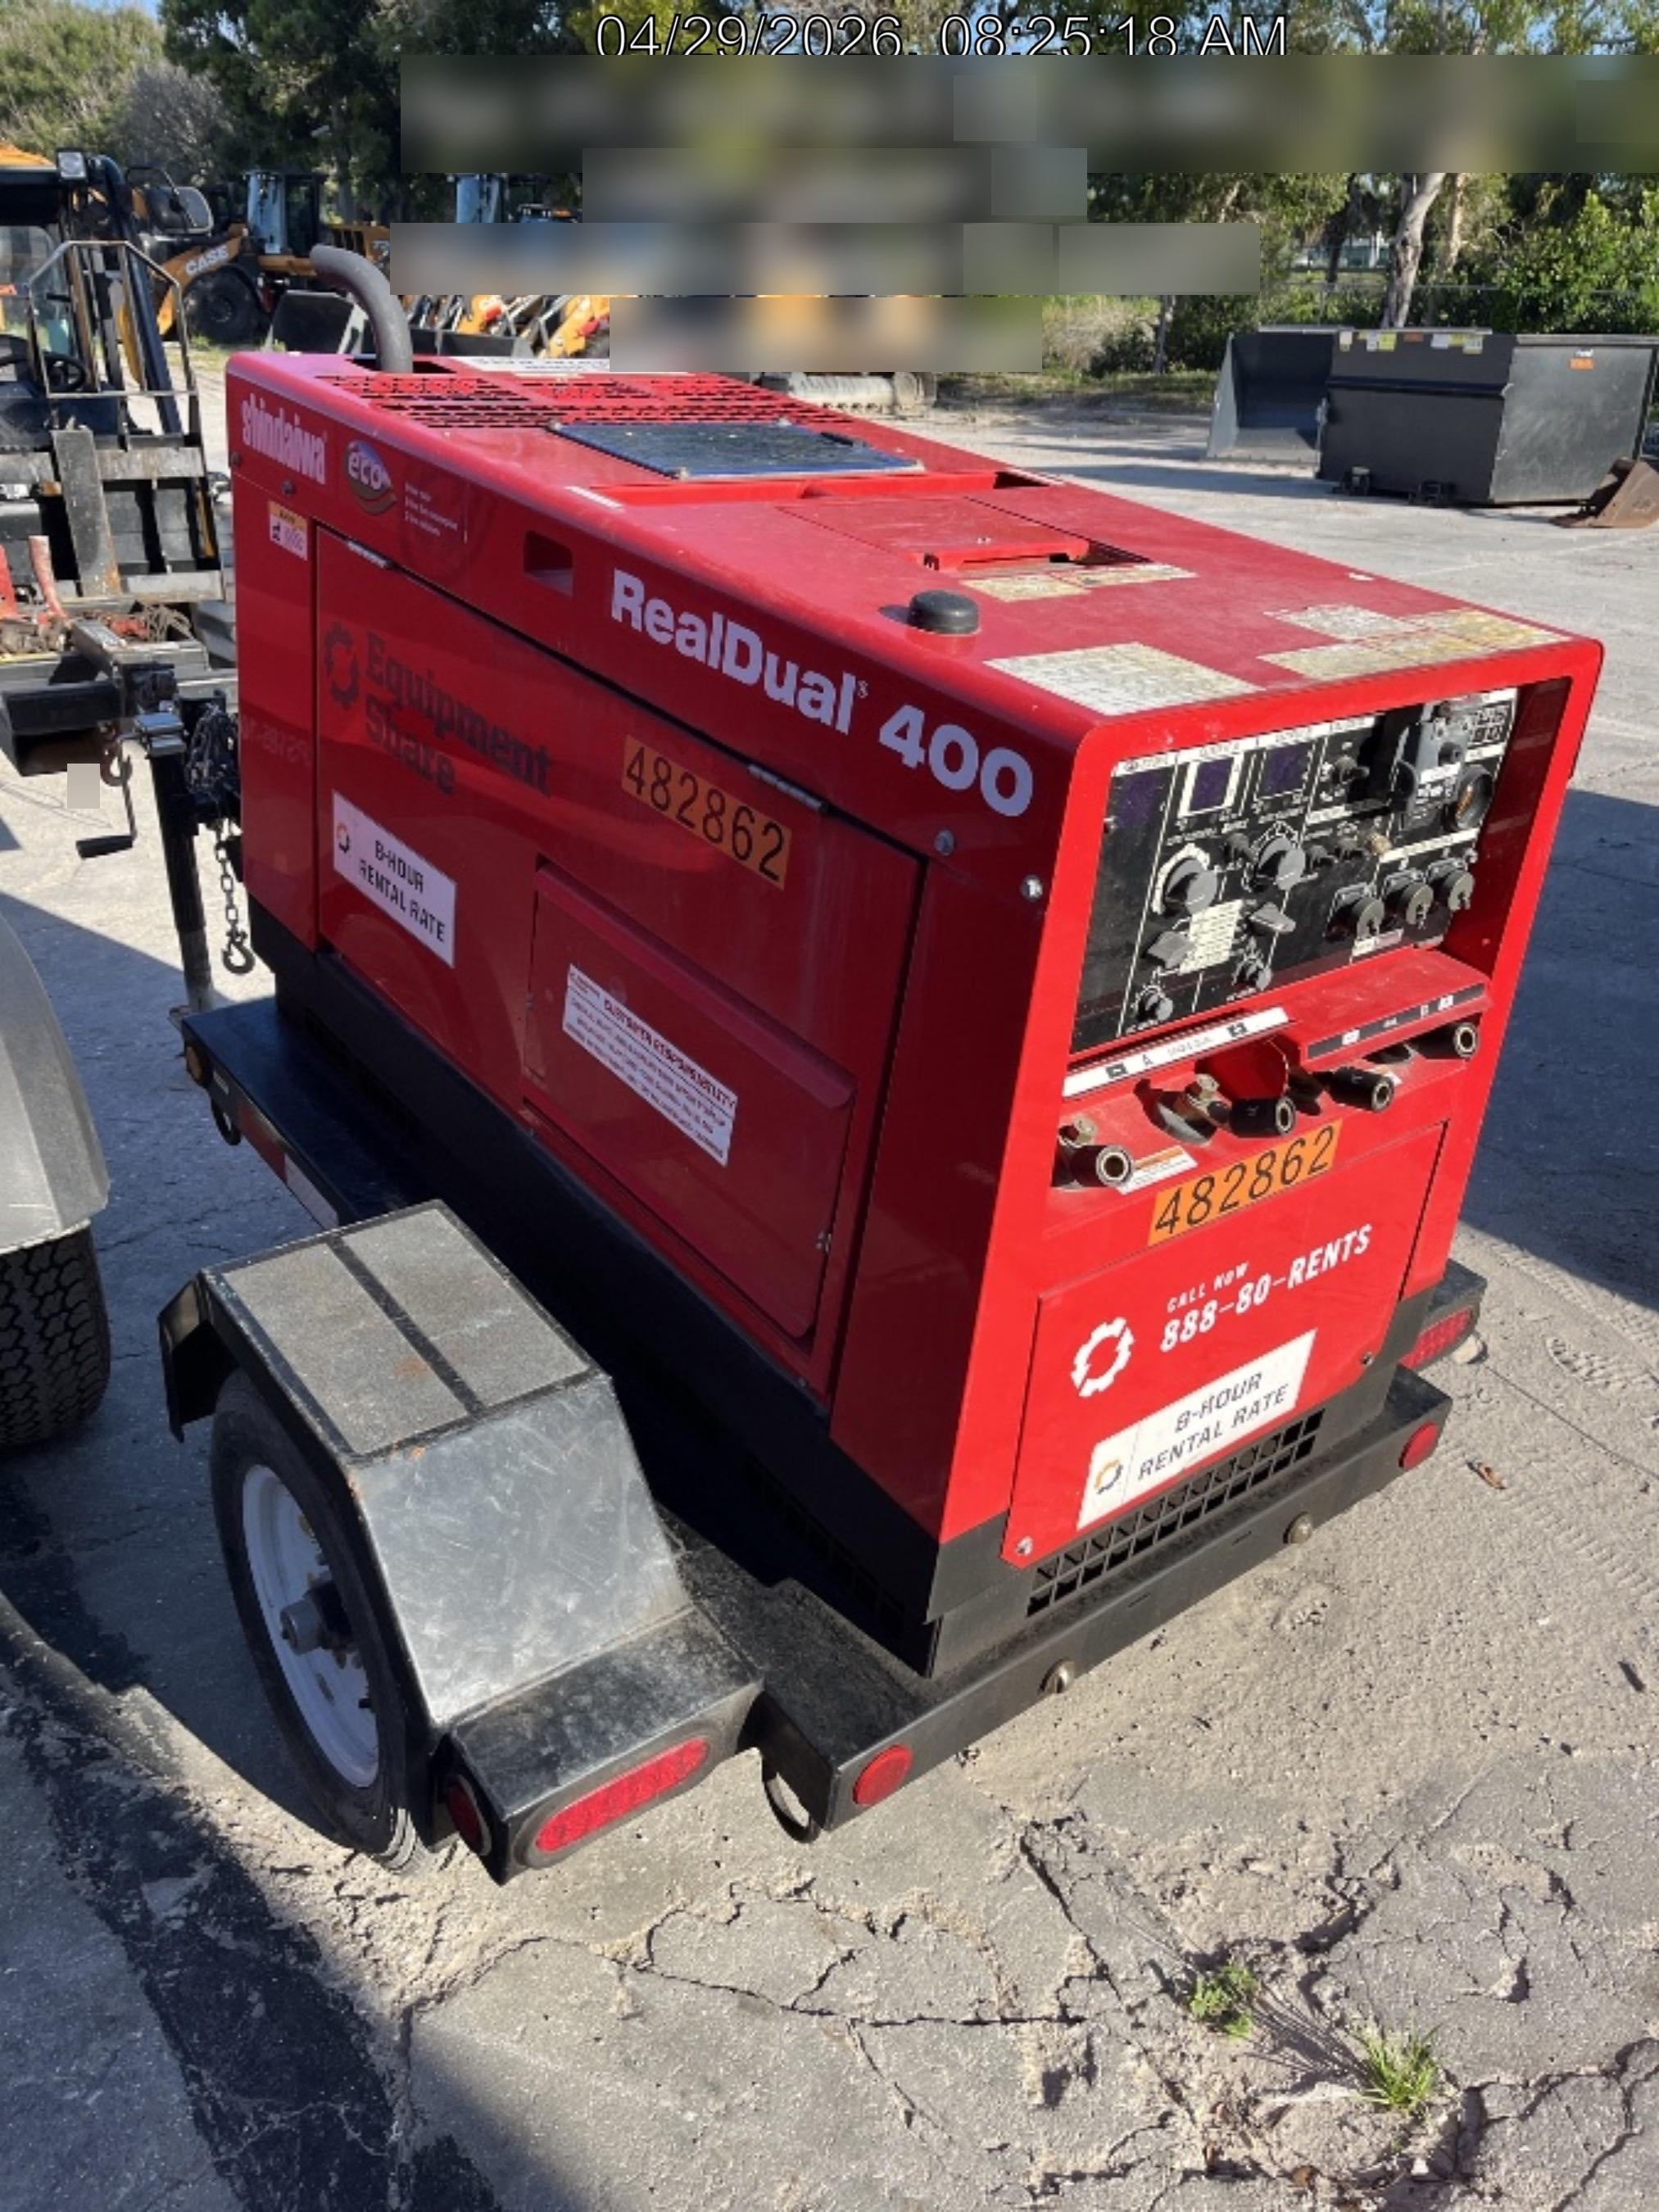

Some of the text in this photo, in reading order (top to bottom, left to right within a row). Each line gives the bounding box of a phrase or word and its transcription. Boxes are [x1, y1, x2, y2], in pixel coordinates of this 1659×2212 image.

[185, 243, 229, 276] CASE
[242, 392, 326, 485] shindaiwa
[347, 451, 383, 491] eco
[365, 629, 551, 799] Equipment
[365, 691, 454, 797] Share
[879, 705, 1033, 817] 400
[626, 746, 785, 882] 482862
[359, 859, 446, 943] RENTAL RATE
[1154, 1124, 1335, 1235] 482862
[1159, 1223, 1372, 1353] 888-80-RENTS
[1166, 1260, 1250, 1313] CALL NOW
[1137, 1383, 1290, 1481] RENTAL RATE
[1174, 1371, 1263, 1434] 8-HOUR
